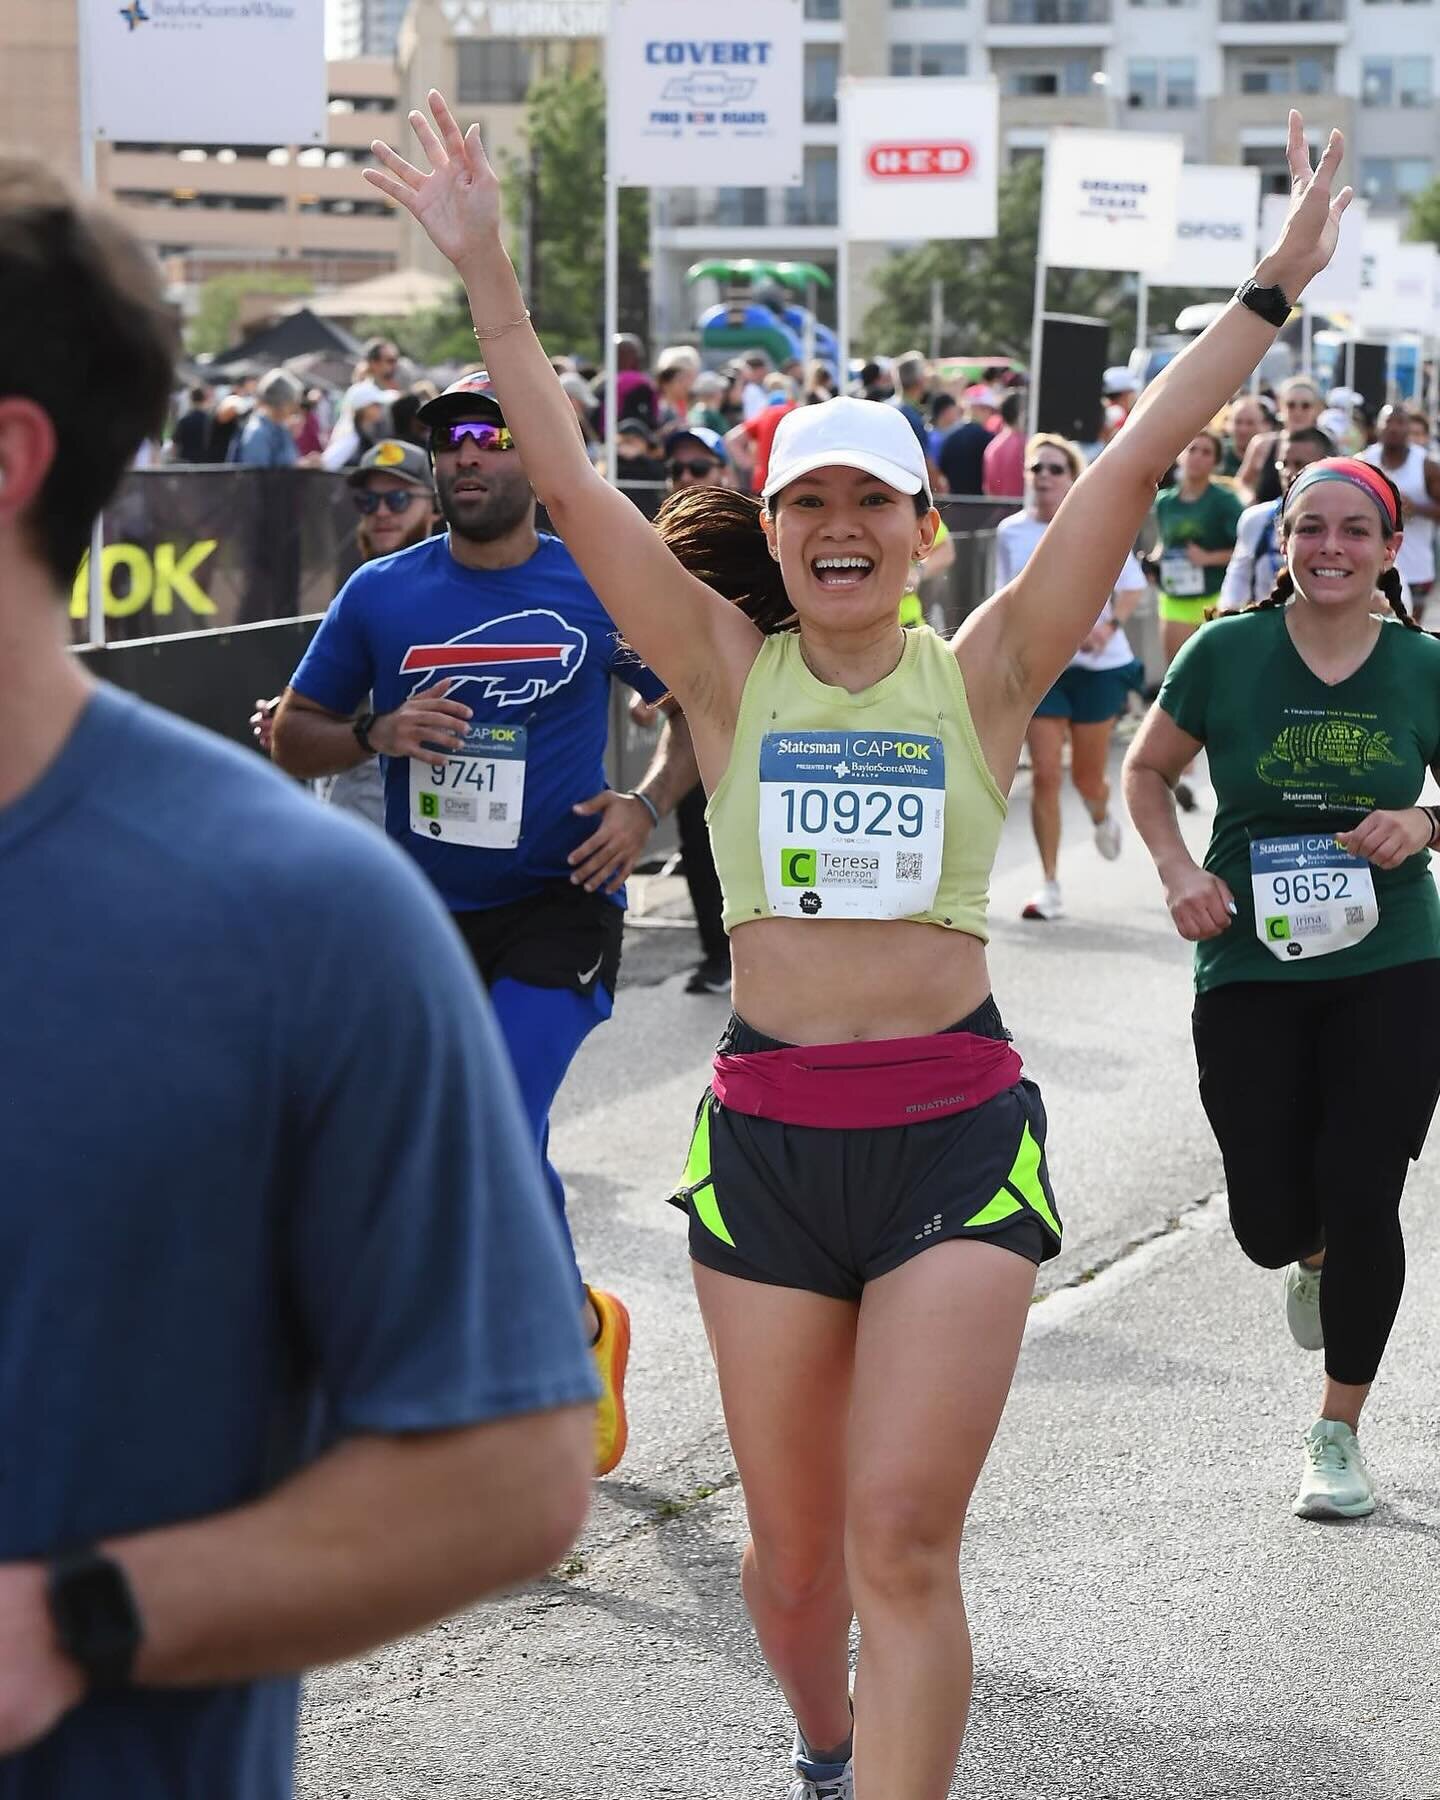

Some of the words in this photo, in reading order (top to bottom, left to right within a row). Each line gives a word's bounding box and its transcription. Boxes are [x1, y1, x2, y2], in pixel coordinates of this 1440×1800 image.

[645, 41, 772, 64] COVERT
[778, 738, 841, 756] Statesman
[852, 740, 932, 761] CAP10K
[431, 759, 496, 793] 9741
[851, 762, 929, 775] BaylorScott&White
[422, 796, 434, 815] B
[1282, 791, 1322, 801] Statesman
[780, 789, 924, 838] 10929
[1258, 842, 1300, 855] Statesman
[789, 853, 811, 883] C
[821, 853, 879, 870] Teresa
[826, 869, 872, 878] Anderson
[1272, 872, 1352, 905] 9652
[1269, 919, 1285, 938] C
[1296, 914, 1322, 927] Irina
[917, 1095, 965, 1112] NATHAN
